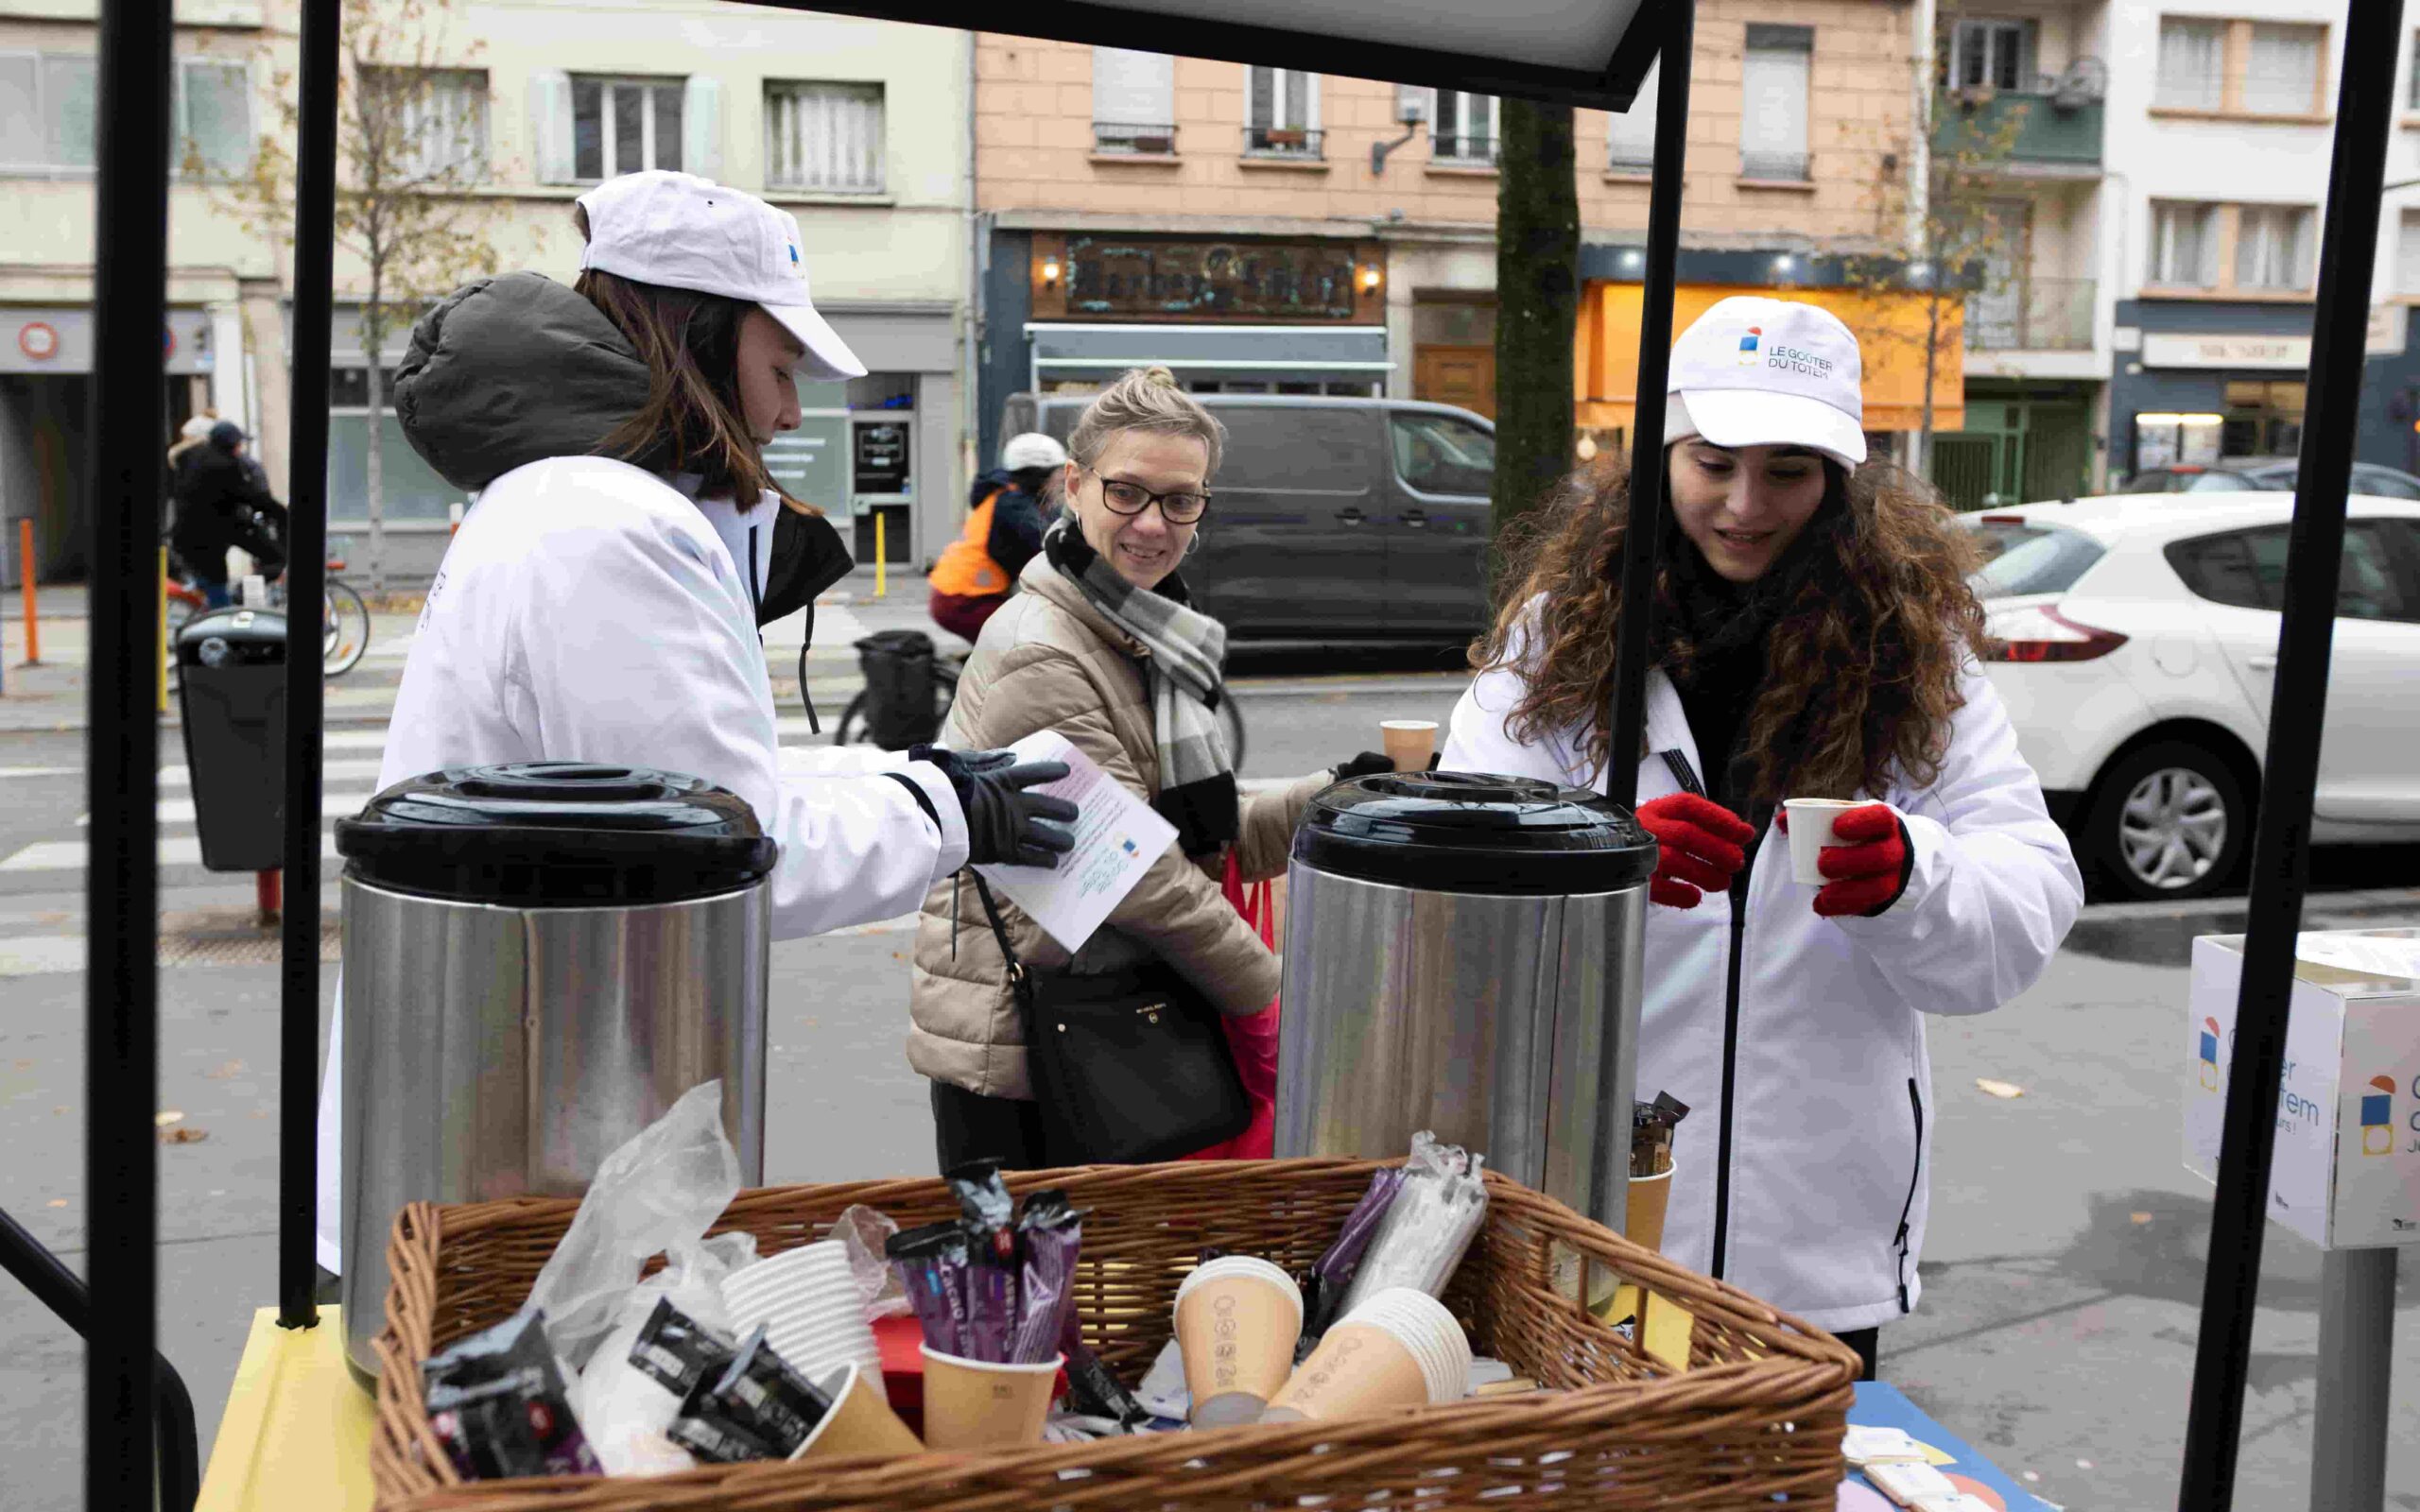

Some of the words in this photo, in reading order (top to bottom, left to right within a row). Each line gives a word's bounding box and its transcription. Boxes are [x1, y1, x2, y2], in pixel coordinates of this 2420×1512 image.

[1770, 346, 1787, 356] LE
[1768, 358, 1789, 369] DU
[2279, 1081, 2320, 1126] tem
